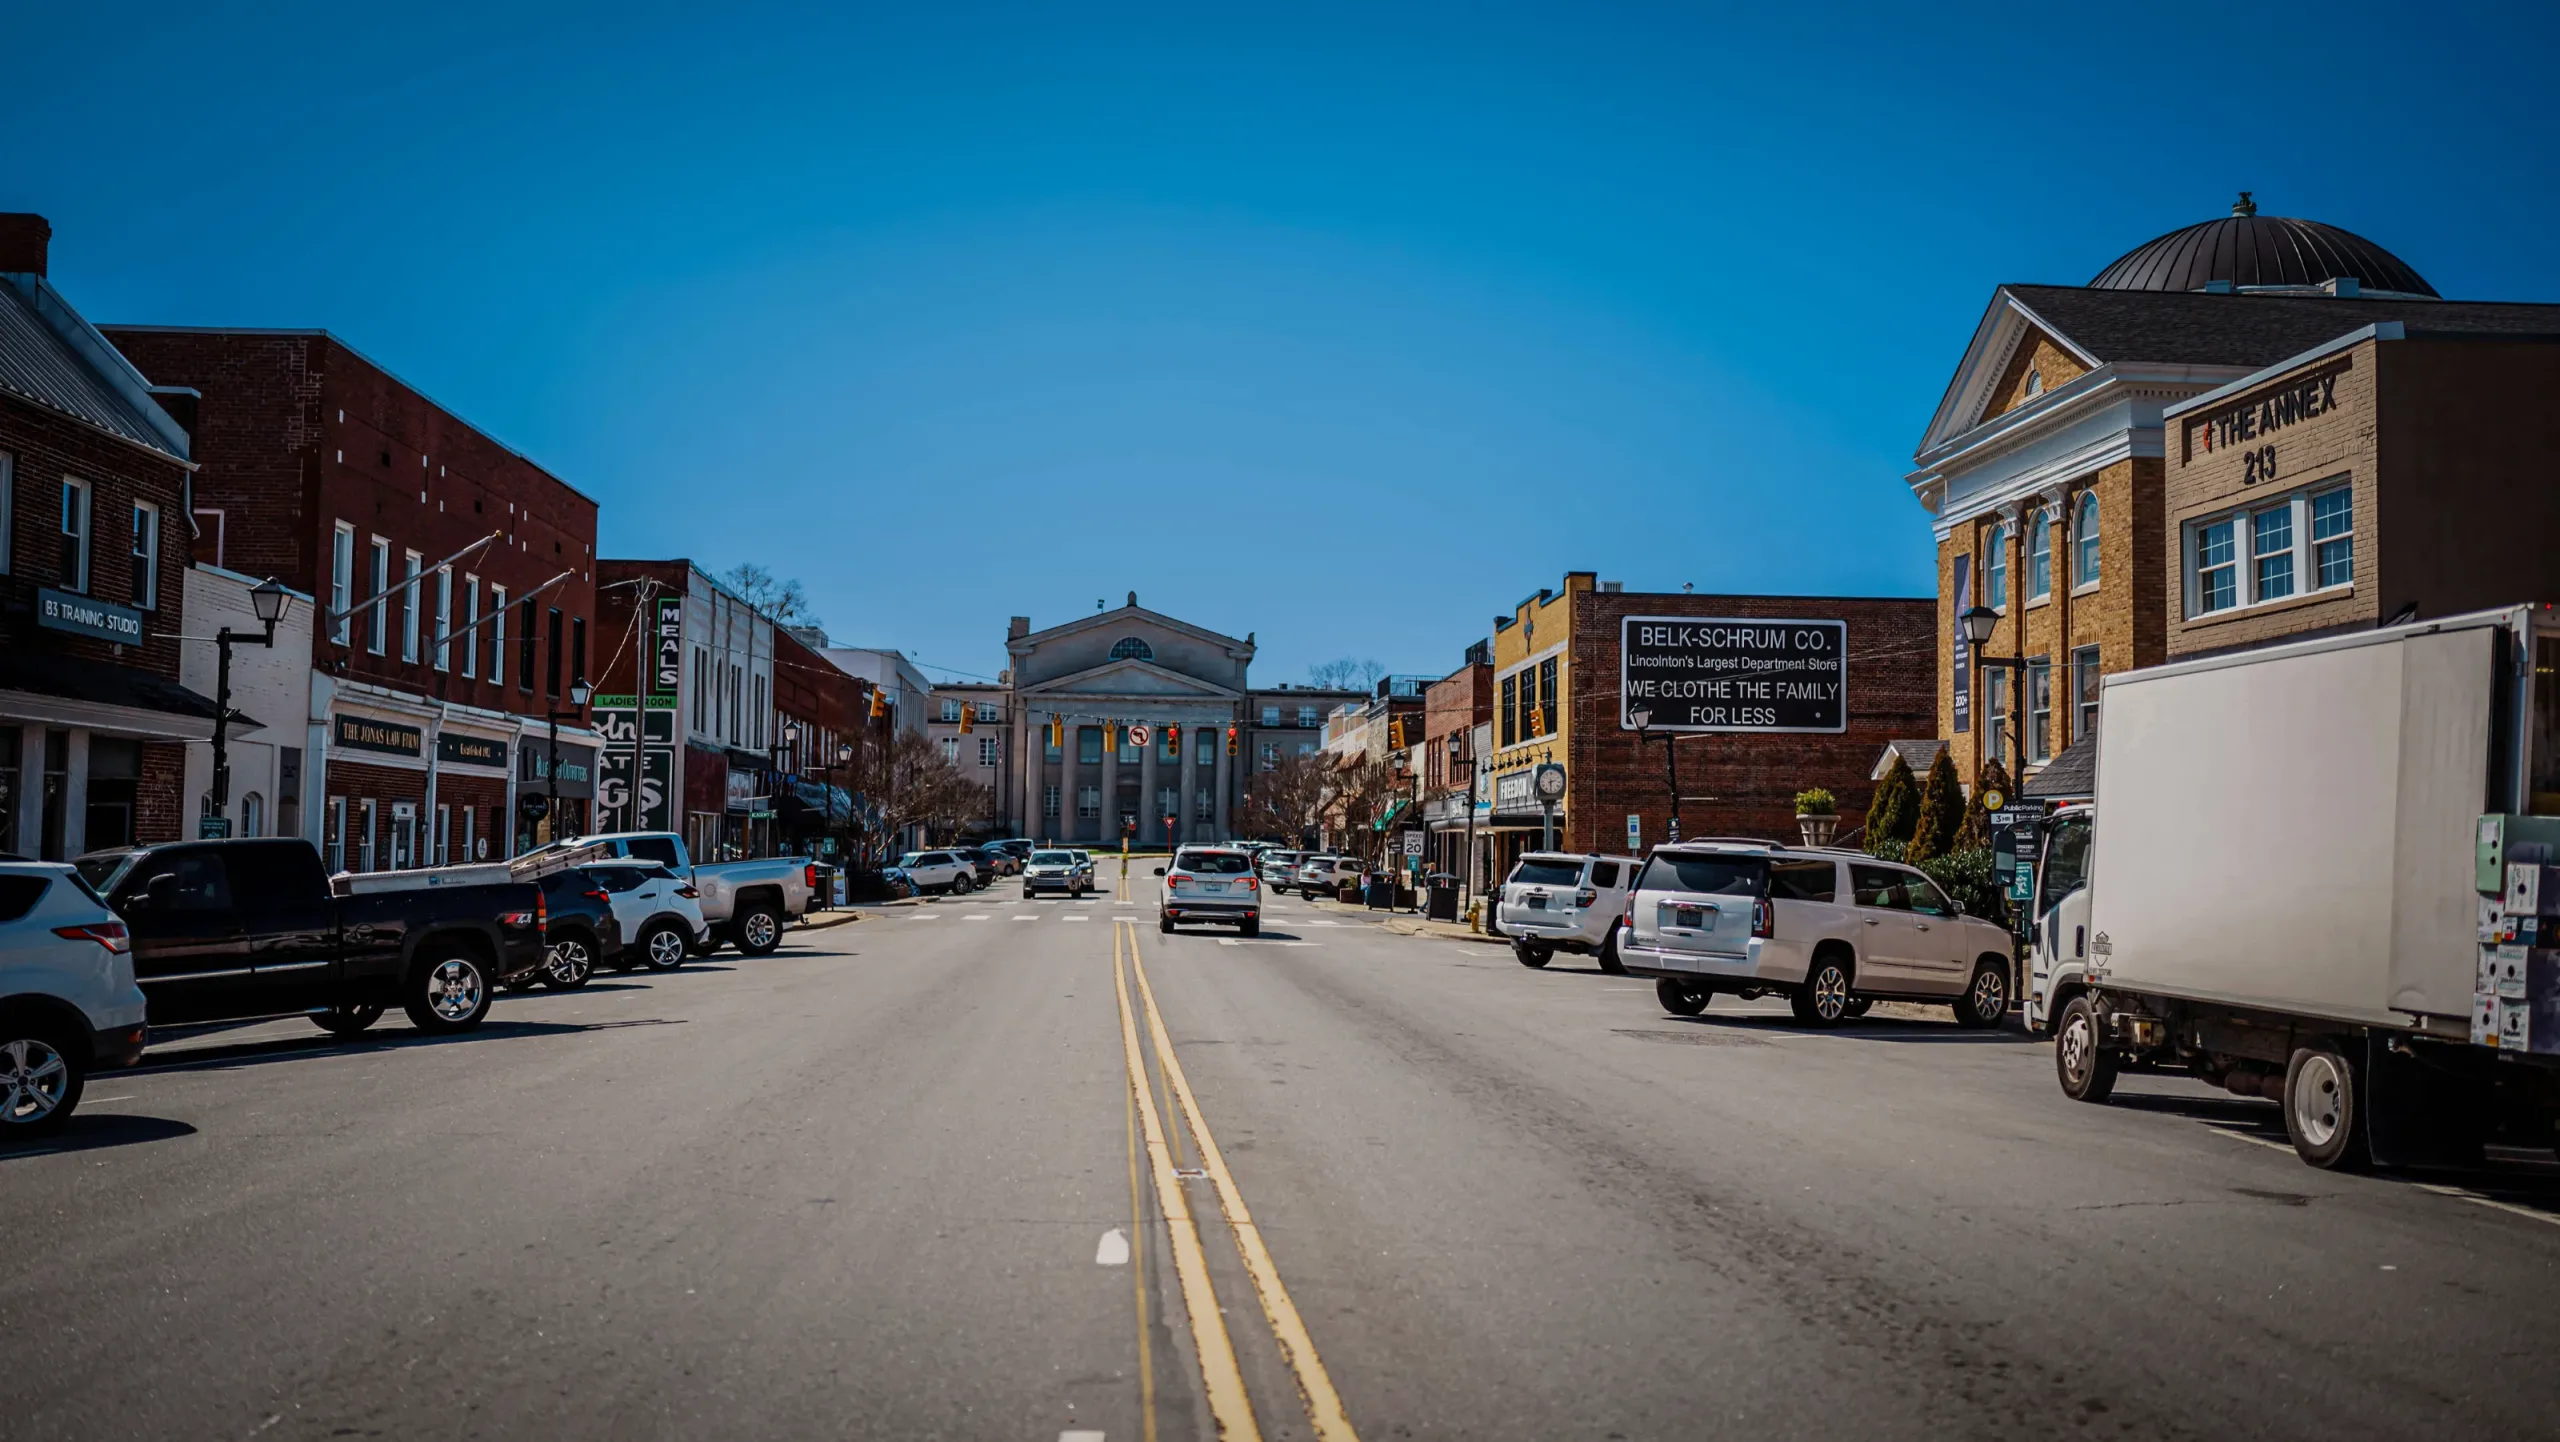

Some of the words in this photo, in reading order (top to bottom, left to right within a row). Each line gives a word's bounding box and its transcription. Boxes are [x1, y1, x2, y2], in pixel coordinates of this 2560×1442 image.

[2217, 405, 2256, 449] THE
[2259, 373, 2336, 436] ANNEX
[2244, 445, 2276, 485] 213
[46, 600, 58, 617] B3
[61, 604, 104, 628] TRAINING
[107, 614, 139, 635] STUDIO
[659, 608, 680, 685] MEALS
[1640, 626, 1785, 650] BELK-SCHRUM
[1794, 630, 1832, 651] CO.
[1629, 654, 1694, 670] Lincolnton's
[1697, 655, 1738, 672] Largest
[1741, 656, 1805, 673] Department
[1808, 657, 1838, 672] Store
[602, 696, 638, 706] LADIES
[1628, 679, 1656, 697] WE
[1661, 680, 1731, 699] CLOTHE
[1735, 681, 1771, 699] THE
[1776, 682, 1839, 701] FAMILY
[1690, 706, 1727, 724] FOR
[1731, 707, 1776, 726] LESS
[343, 722, 359, 741] THE
[360, 725, 384, 745] JONAS
[386, 729, 401, 748] LAW
[401, 732, 419, 751] FIRM
[599, 756, 652, 770] ATE
[2022, 804, 2043, 812] Parking
[1407, 843, 1421, 853] 20
